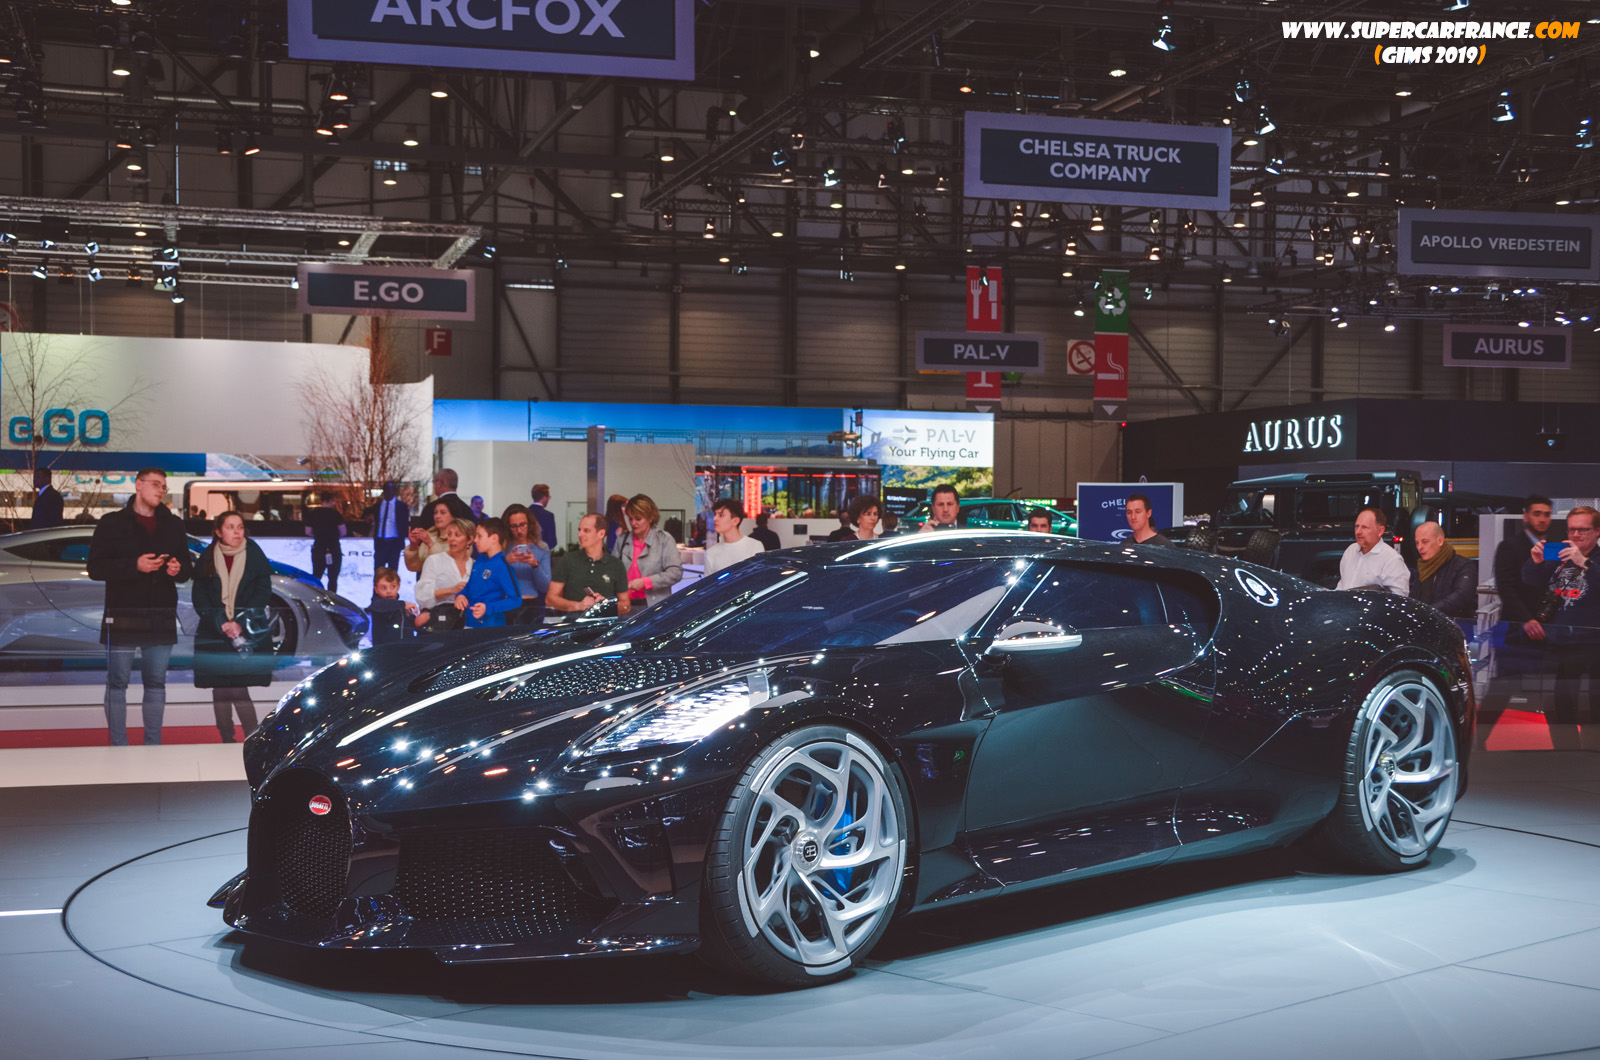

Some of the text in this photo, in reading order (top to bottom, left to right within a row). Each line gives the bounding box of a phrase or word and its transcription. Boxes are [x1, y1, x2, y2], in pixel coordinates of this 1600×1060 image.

[370, 0, 626, 38] ARCFOX
[1019, 138, 1181, 164] CHELSEA TRUCK
[1050, 162, 1151, 183] COMPANY
[1420, 235, 1580, 252] APOLLO VREDESTEIN
[354, 280, 424, 303] E.GO
[433, 331, 446, 349] F
[1474, 338, 1544, 355] AURUS
[953, 344, 1010, 360] PAL-V
[1243, 414, 1342, 452] AURUS
[889, 446, 980, 461] Your Flying Car
